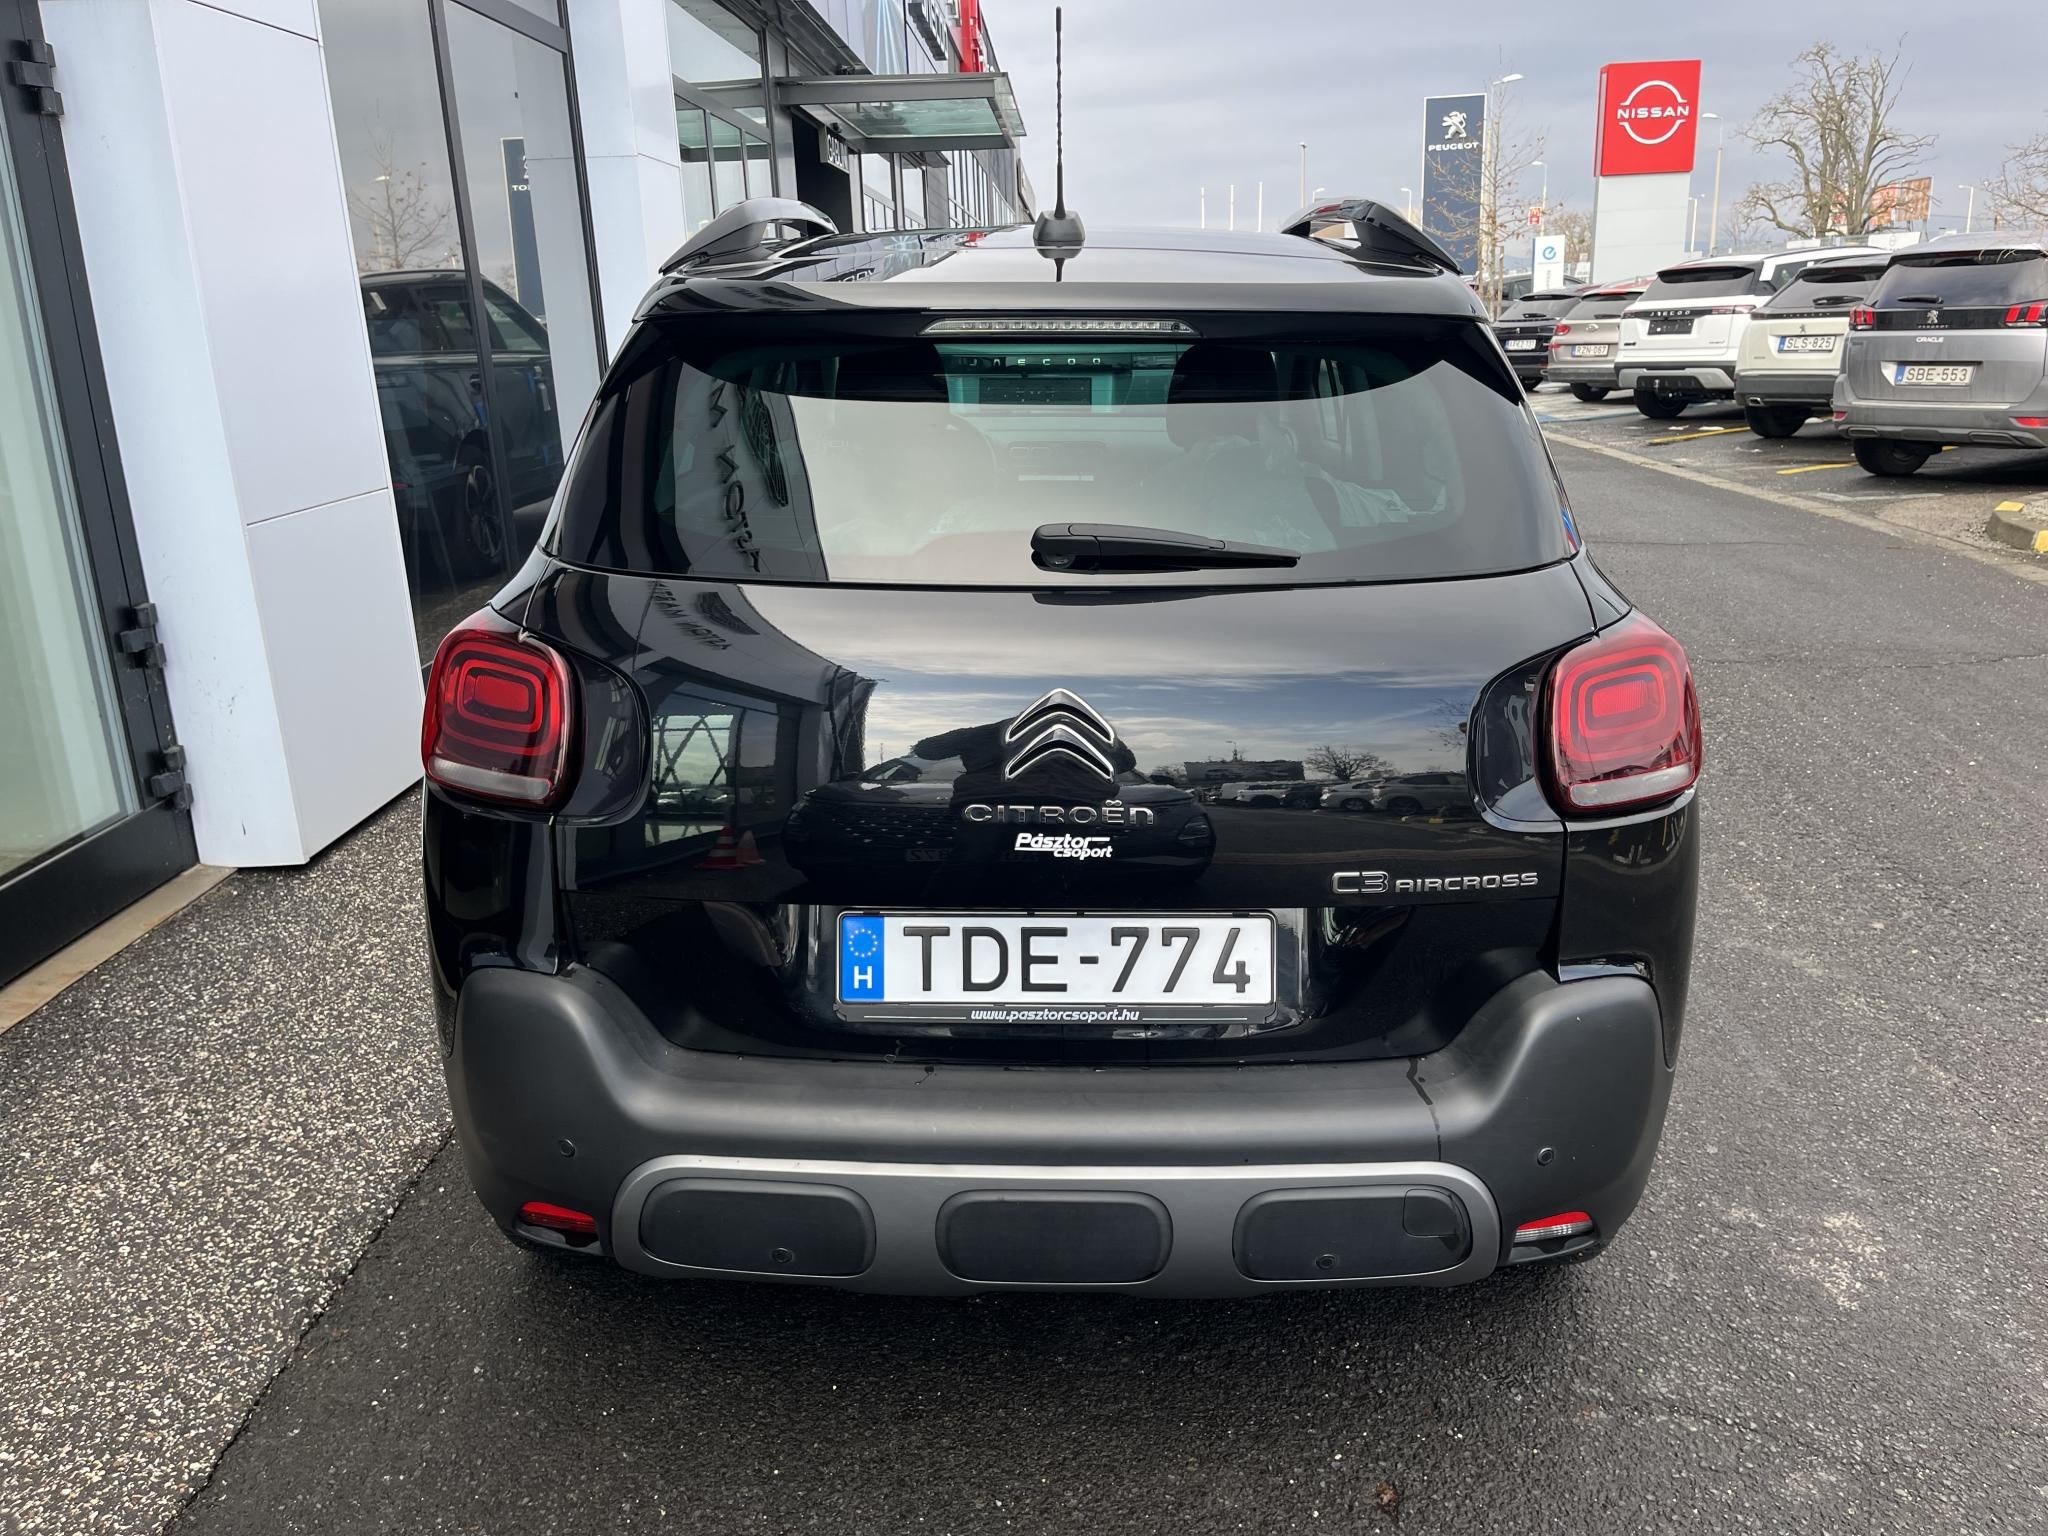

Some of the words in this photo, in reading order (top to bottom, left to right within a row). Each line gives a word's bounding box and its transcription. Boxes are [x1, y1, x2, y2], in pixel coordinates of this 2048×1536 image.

[1617, 106, 1689, 119] NISSAN
[1428, 142, 1480, 151] PEUGEOT
[1786, 337, 1832, 349] SLS-825
[968, 358, 1102, 366] JAECOO
[1906, 367, 1968, 382] SBE-553
[1015, 832, 1111, 850] Pásztor
[1053, 847, 1113, 861] csoport
[1332, 871, 1389, 894] C3
[1395, 872, 1539, 893] AIRCROSS
[853, 965, 873, 989] H
[903, 926, 1251, 993] TDE-774
[970, 1008, 1140, 1024] www.pasztorcsoport.hu
